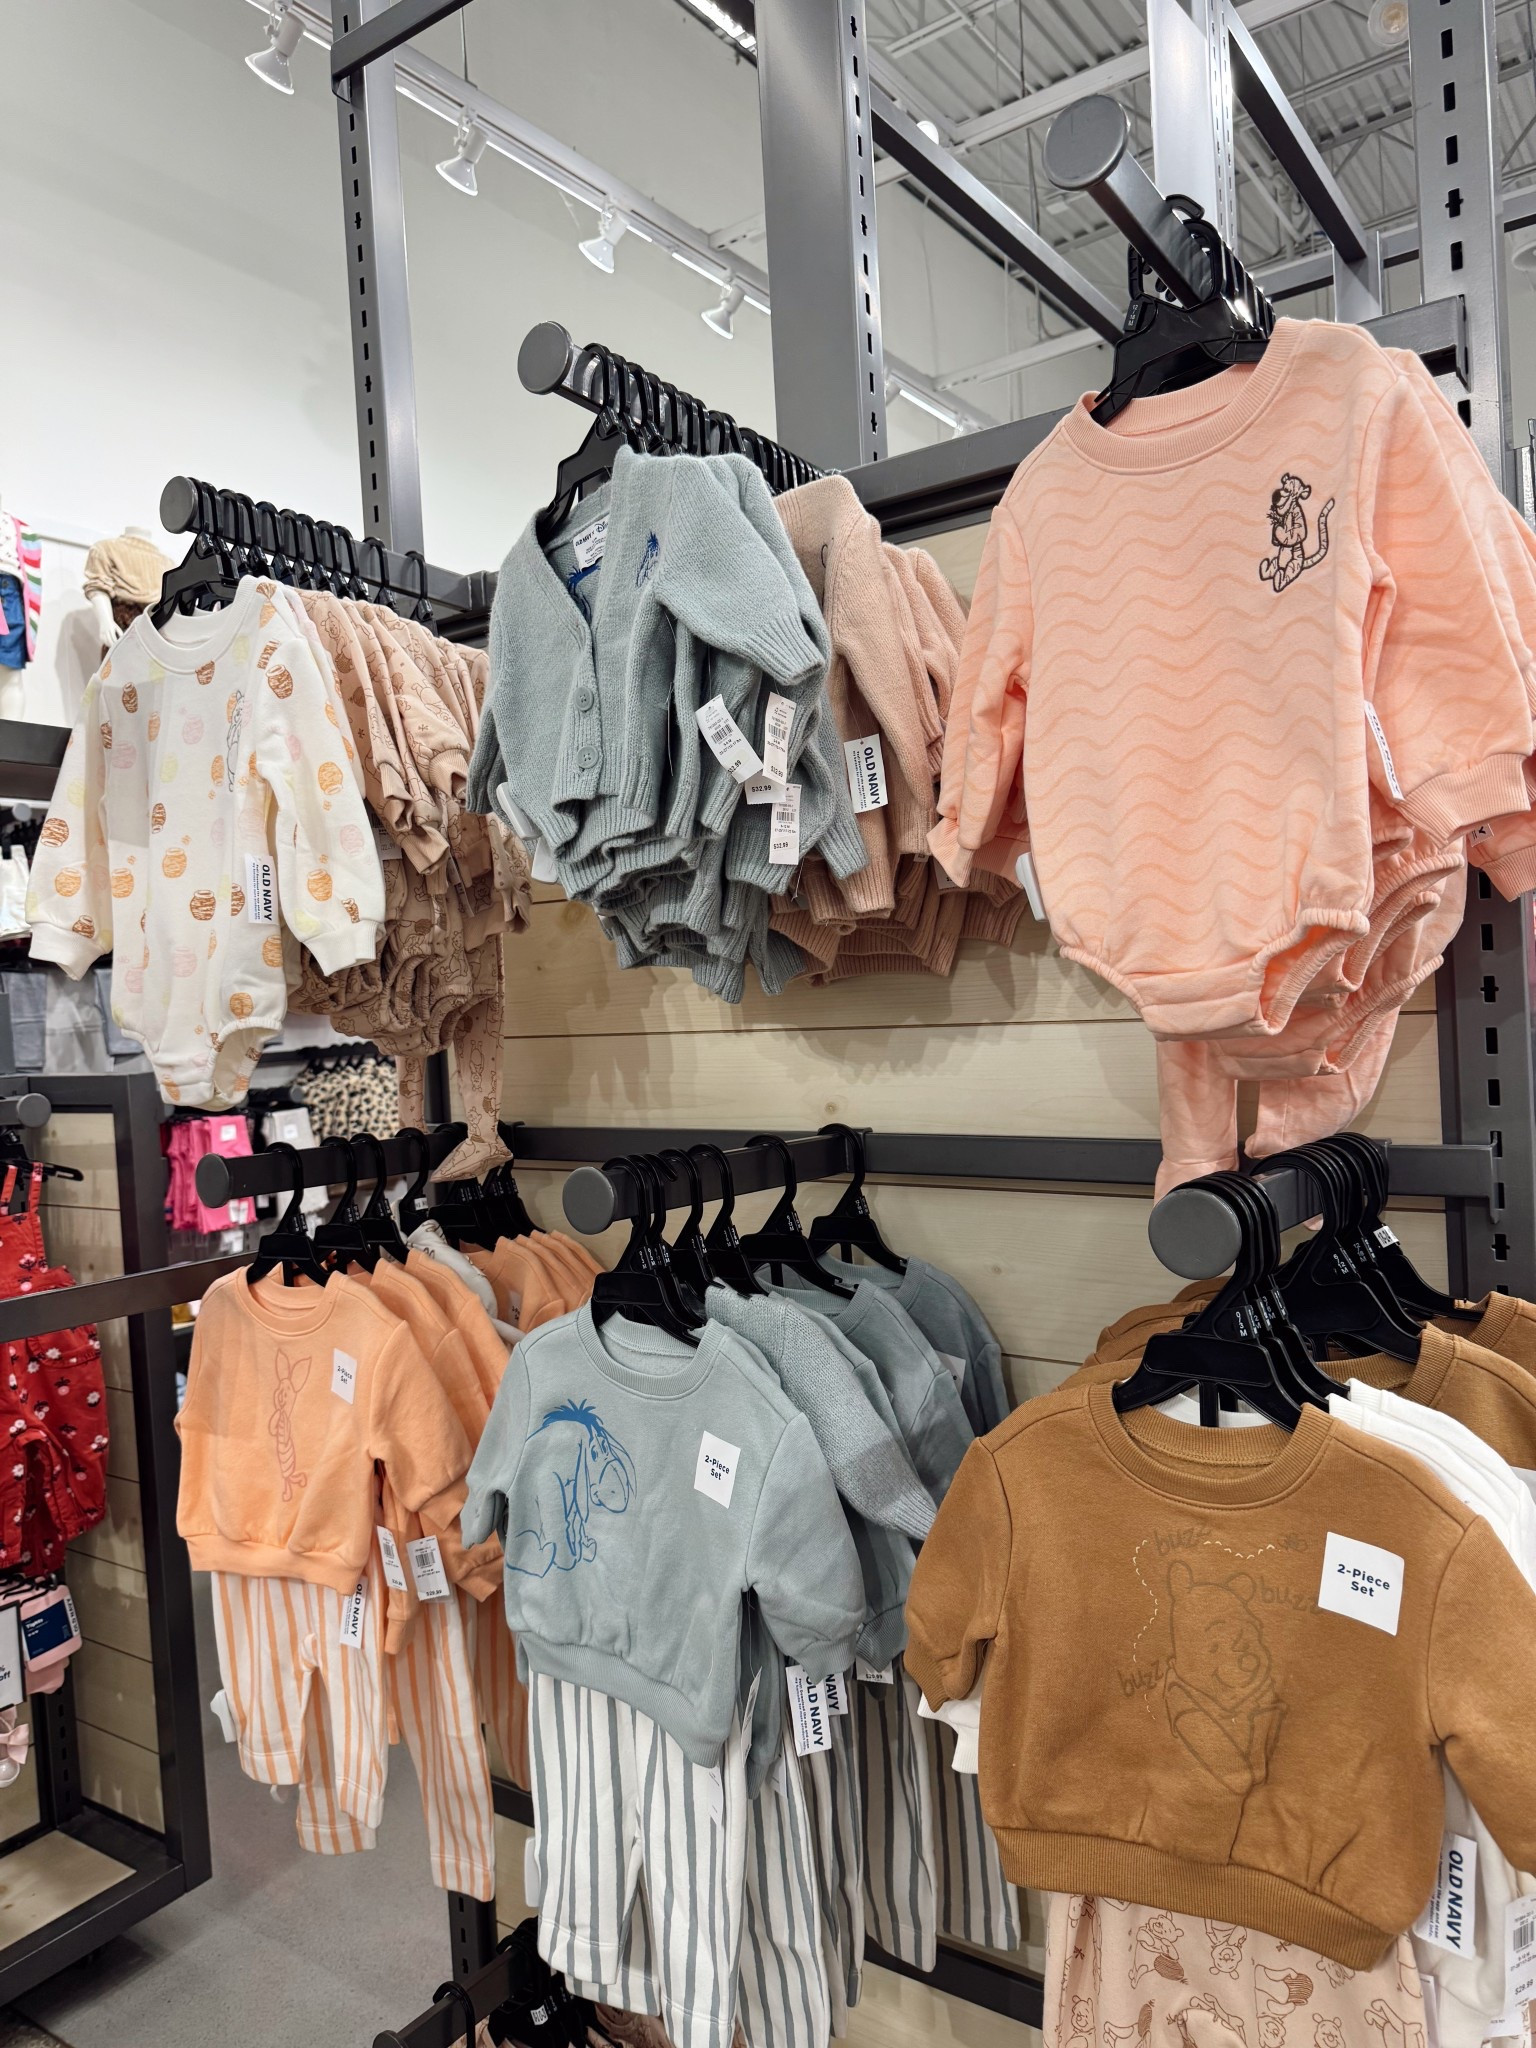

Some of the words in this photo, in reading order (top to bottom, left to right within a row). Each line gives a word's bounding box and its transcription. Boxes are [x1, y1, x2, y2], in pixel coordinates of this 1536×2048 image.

[864, 746, 876, 771] OLD
[867, 772, 880, 805] NAVY
[262, 864, 271, 887] OLD
[263, 889, 272, 921] NAVY
[704, 1454, 730, 1475] 2-Piece
[710, 1468, 721, 1481] Set
[1337, 1563, 1391, 1591] 2-Piece
[1350, 1580, 1375, 1597] Set
[355, 1583, 363, 1605] OLD
[351, 1607, 360, 1637] NAVY
[825, 1673, 840, 1711] NAVY
[1117, 1660, 1166, 1698] buzz
[810, 1706, 824, 1746] NAVY
[1448, 1850, 1464, 1889] OLD
[1446, 1890, 1463, 1949] NAVY
